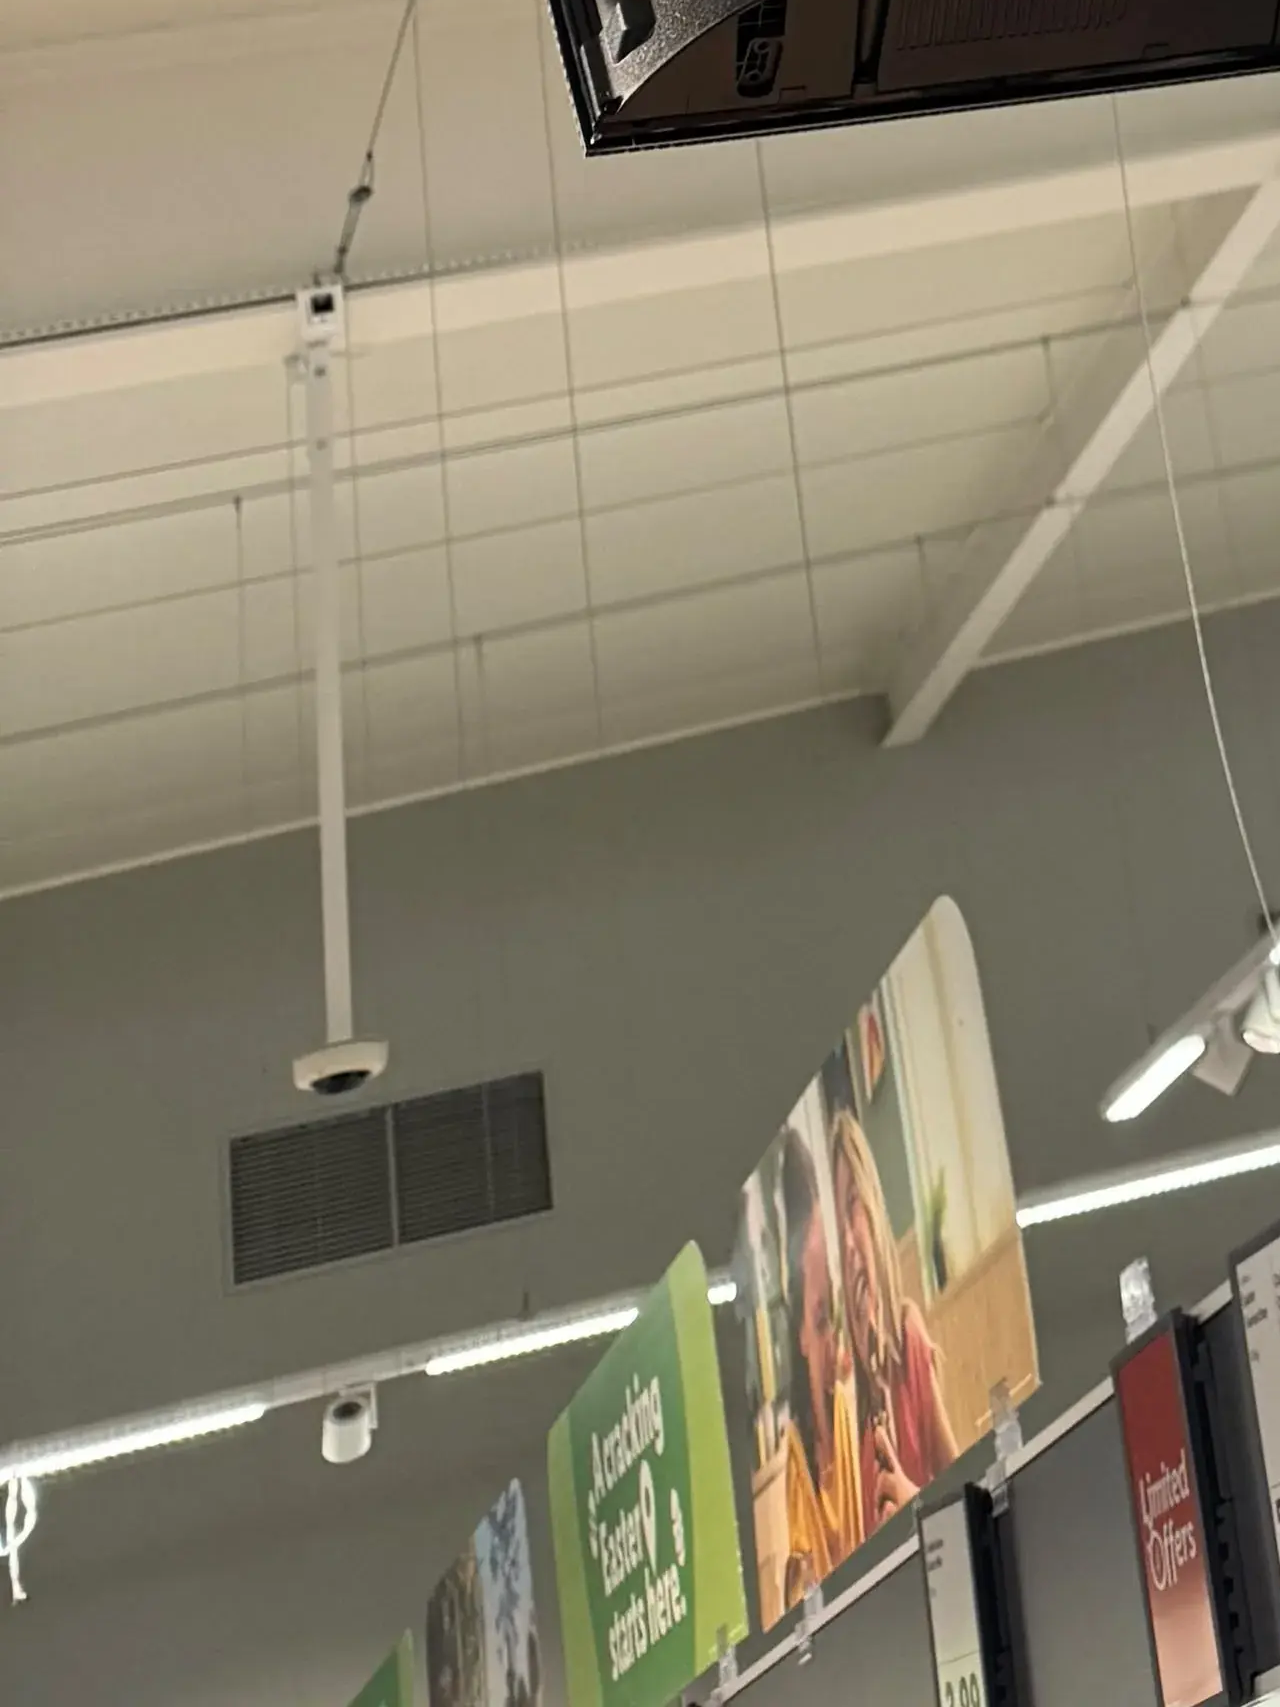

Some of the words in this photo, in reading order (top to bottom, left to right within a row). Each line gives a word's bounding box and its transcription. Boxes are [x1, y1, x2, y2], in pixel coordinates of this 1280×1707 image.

[601, 1372, 666, 1492] cracking
[1138, 1447, 1191, 1526] Limited
[599, 1506, 644, 1598] Easter
[1148, 1518, 1198, 1592] Offers
[608, 1591, 648, 1683] starts
